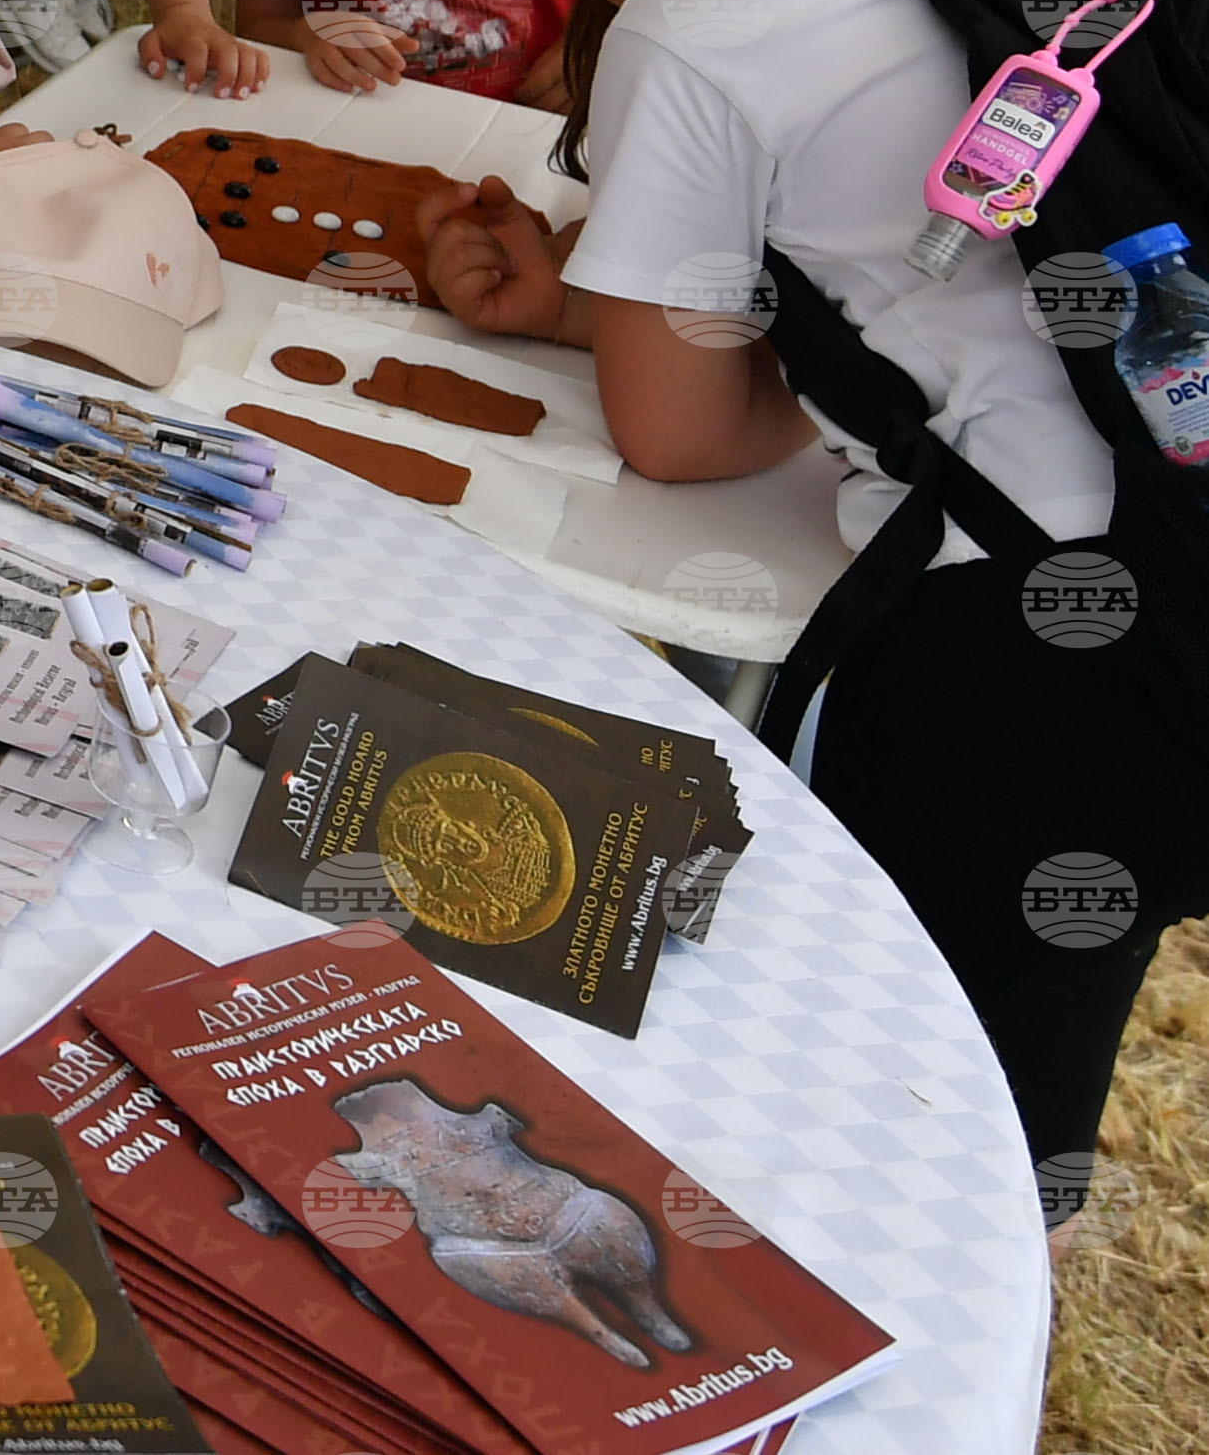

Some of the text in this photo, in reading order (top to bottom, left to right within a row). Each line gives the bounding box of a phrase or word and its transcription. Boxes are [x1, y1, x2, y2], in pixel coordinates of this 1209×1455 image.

[971, 133, 1029, 166] HANDGEL
[990, 108, 1043, 142] Balea
[1165, 374, 1209, 406] DEV
[281, 717, 340, 838] ABRITVS
[320, 731, 375, 858] THE GOLD HOARD
[341, 749, 388, 855] FROM ABRITUS
[562, 812, 623, 979] ЗЛАТНОТО МОНЕТНО
[578, 802, 649, 1005] СЪКРОВИЩЕ ОТ АБРИТУС
[621, 855, 668, 971] www.Abritus.bg
[171, 974, 422, 1060] РЕГИОНАЛЕН ИСТОРИЧЕСКИ МУЗЕЙ РАЗГРАД
[197, 963, 355, 1035] ABRITVS
[211, 1000, 428, 1081] ПРАИСТОРИЧЕСКАТА
[226, 1017, 464, 1107] ЕПОХА В РАЗГРАДСКО
[78, 1081, 163, 1149] ПРАИСТОР
[104, 1118, 181, 1175] ЕПОХА В
[612, 1346, 794, 1429] www.Abritus.bg
